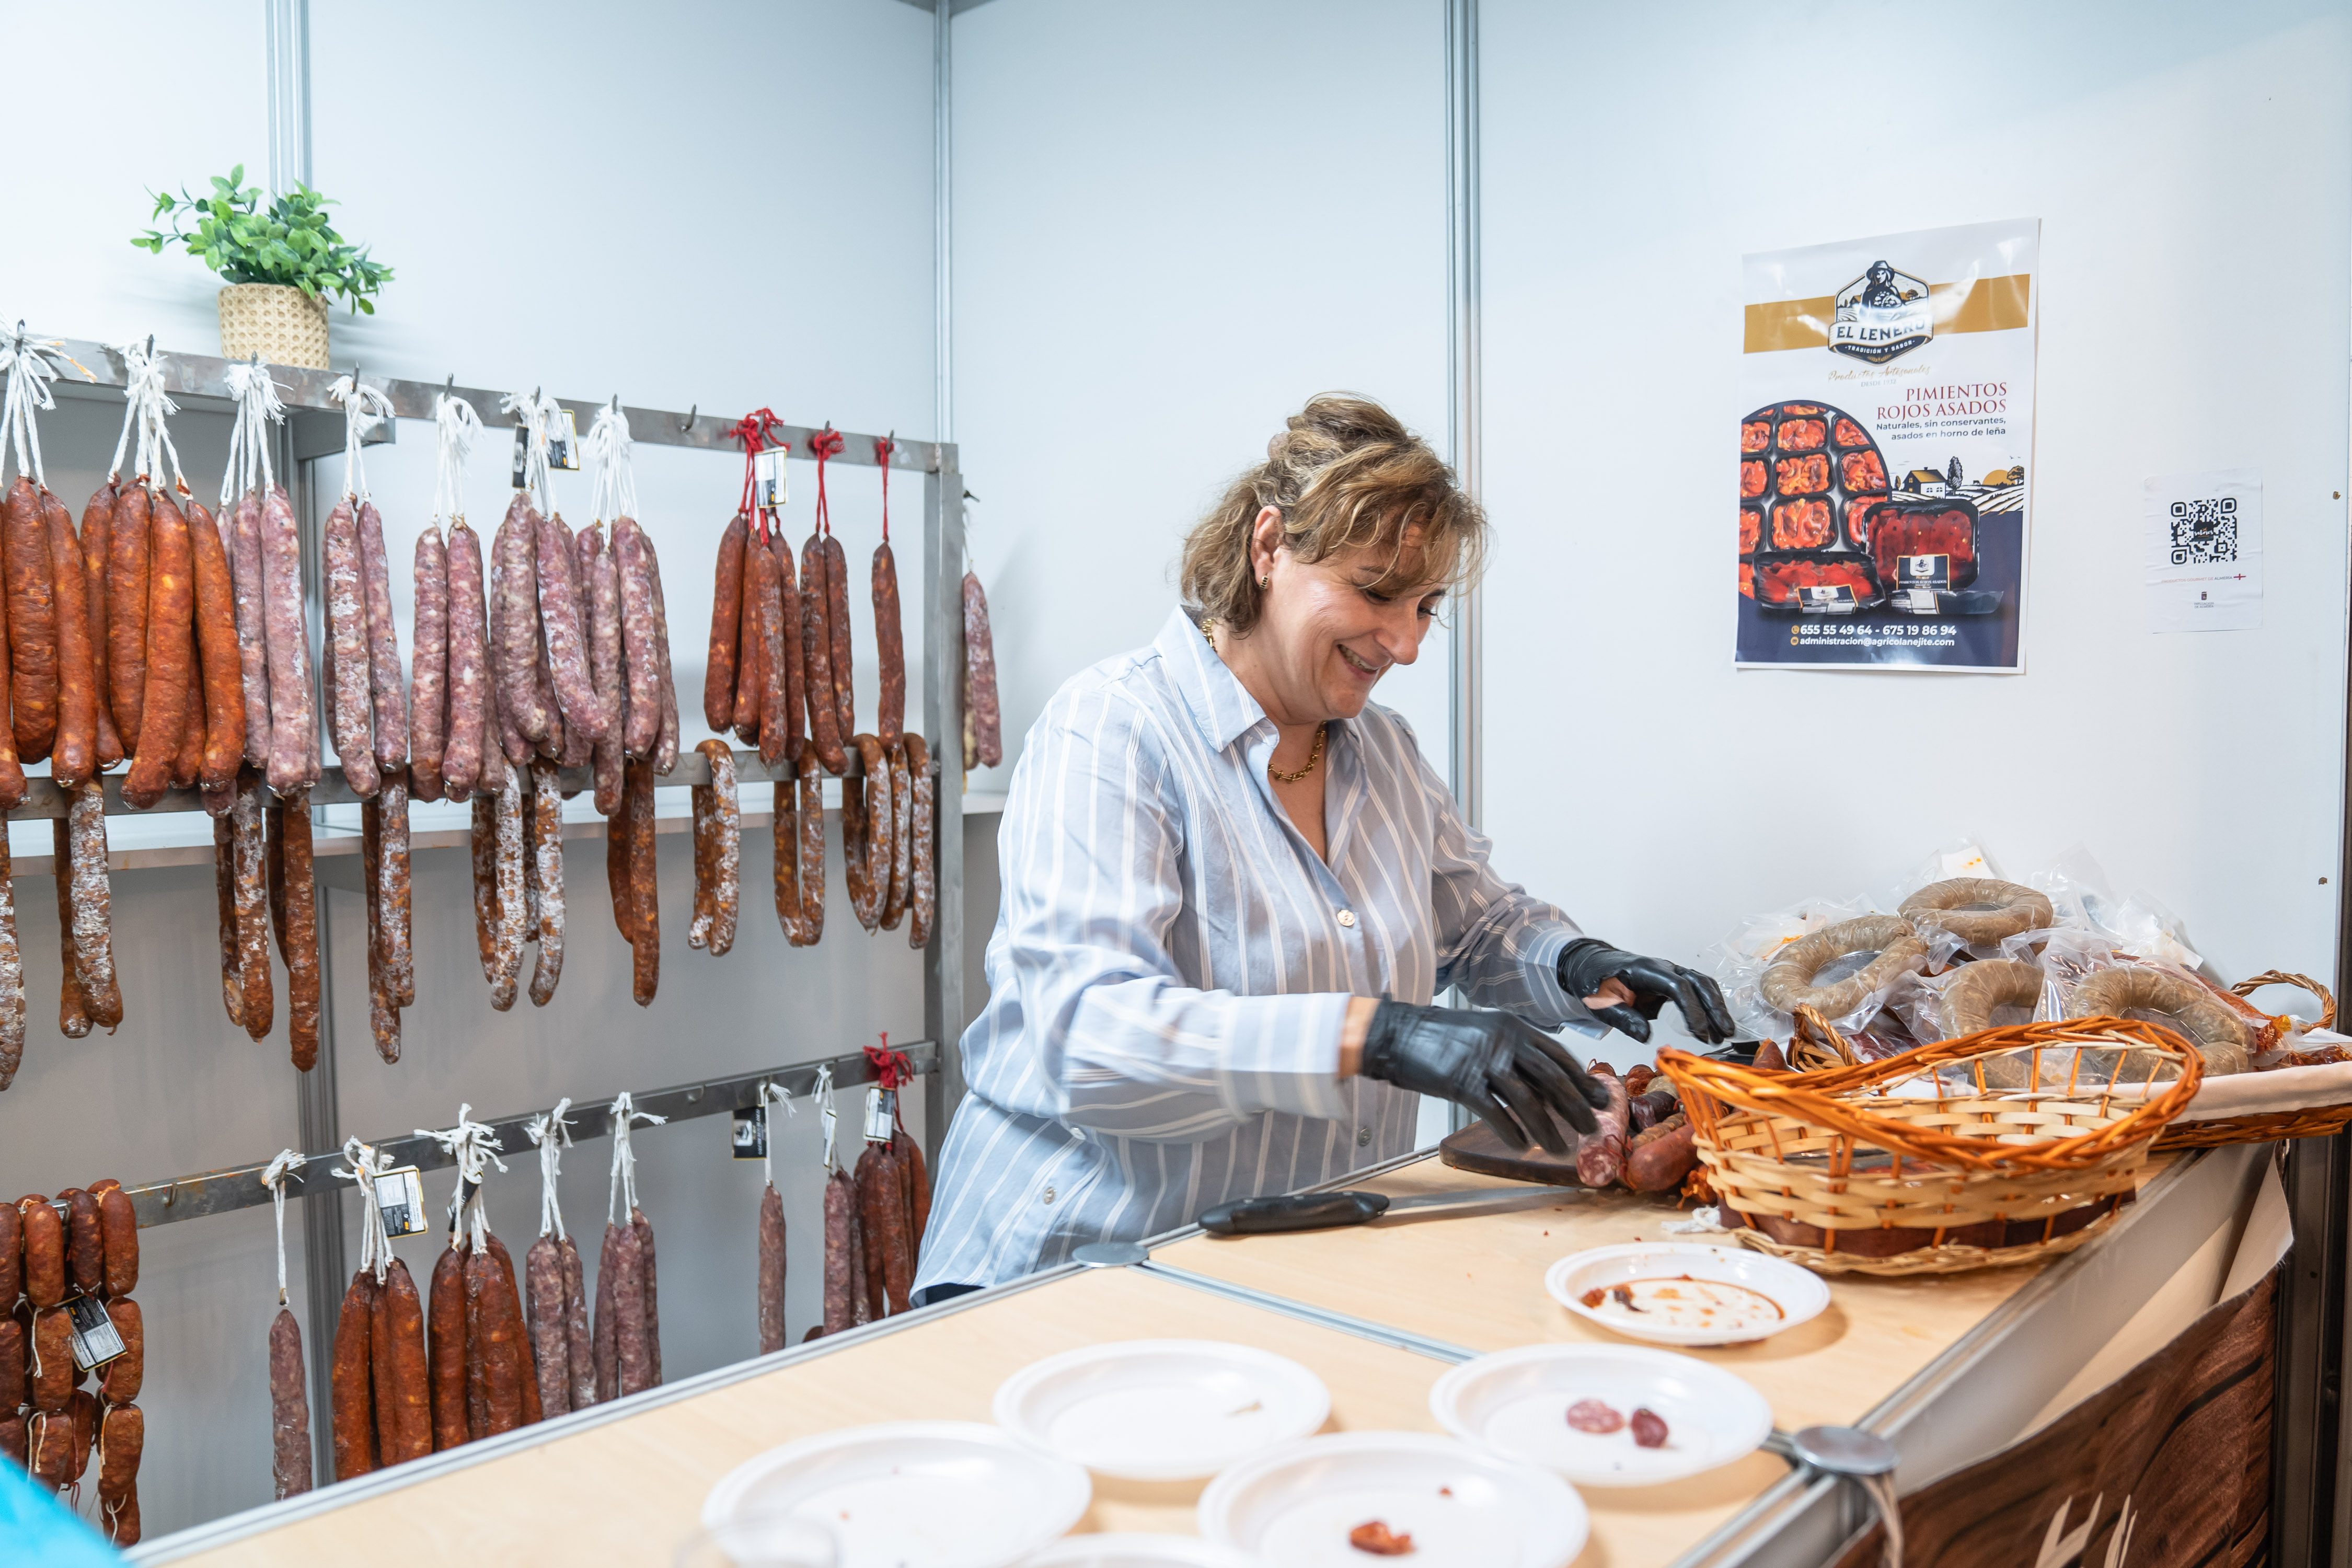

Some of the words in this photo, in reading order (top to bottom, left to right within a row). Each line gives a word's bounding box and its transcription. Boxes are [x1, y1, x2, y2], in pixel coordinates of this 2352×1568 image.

[1837, 326, 1853, 338] EL
[1828, 370, 1874, 383] Productos
[1878, 364, 1931, 377] Artesanales
[1906, 382, 2007, 401] PIMIENTOS
[1877, 403, 1930, 422] ROJOS
[1935, 399, 2007, 417] ASADOS
[1876, 421, 1922, 431] Naturales,
[1941, 417, 2006, 427] conservantes,
[1892, 432, 1923, 440] asados
[1986, 427, 2006, 435] leña
[1800, 625, 1820, 635] 655
[1823, 625, 1837, 635] 55
[1839, 625, 1854, 635] 49
[1857, 625, 1872, 635] 64
[1883, 625, 1904, 635] 675
[1907, 625, 1919, 636] 19
[1922, 625, 1938, 636] 86
[1940, 625, 1957, 636] 94
[1800, 636, 1955, 647] administracion@agricolanejite.com
